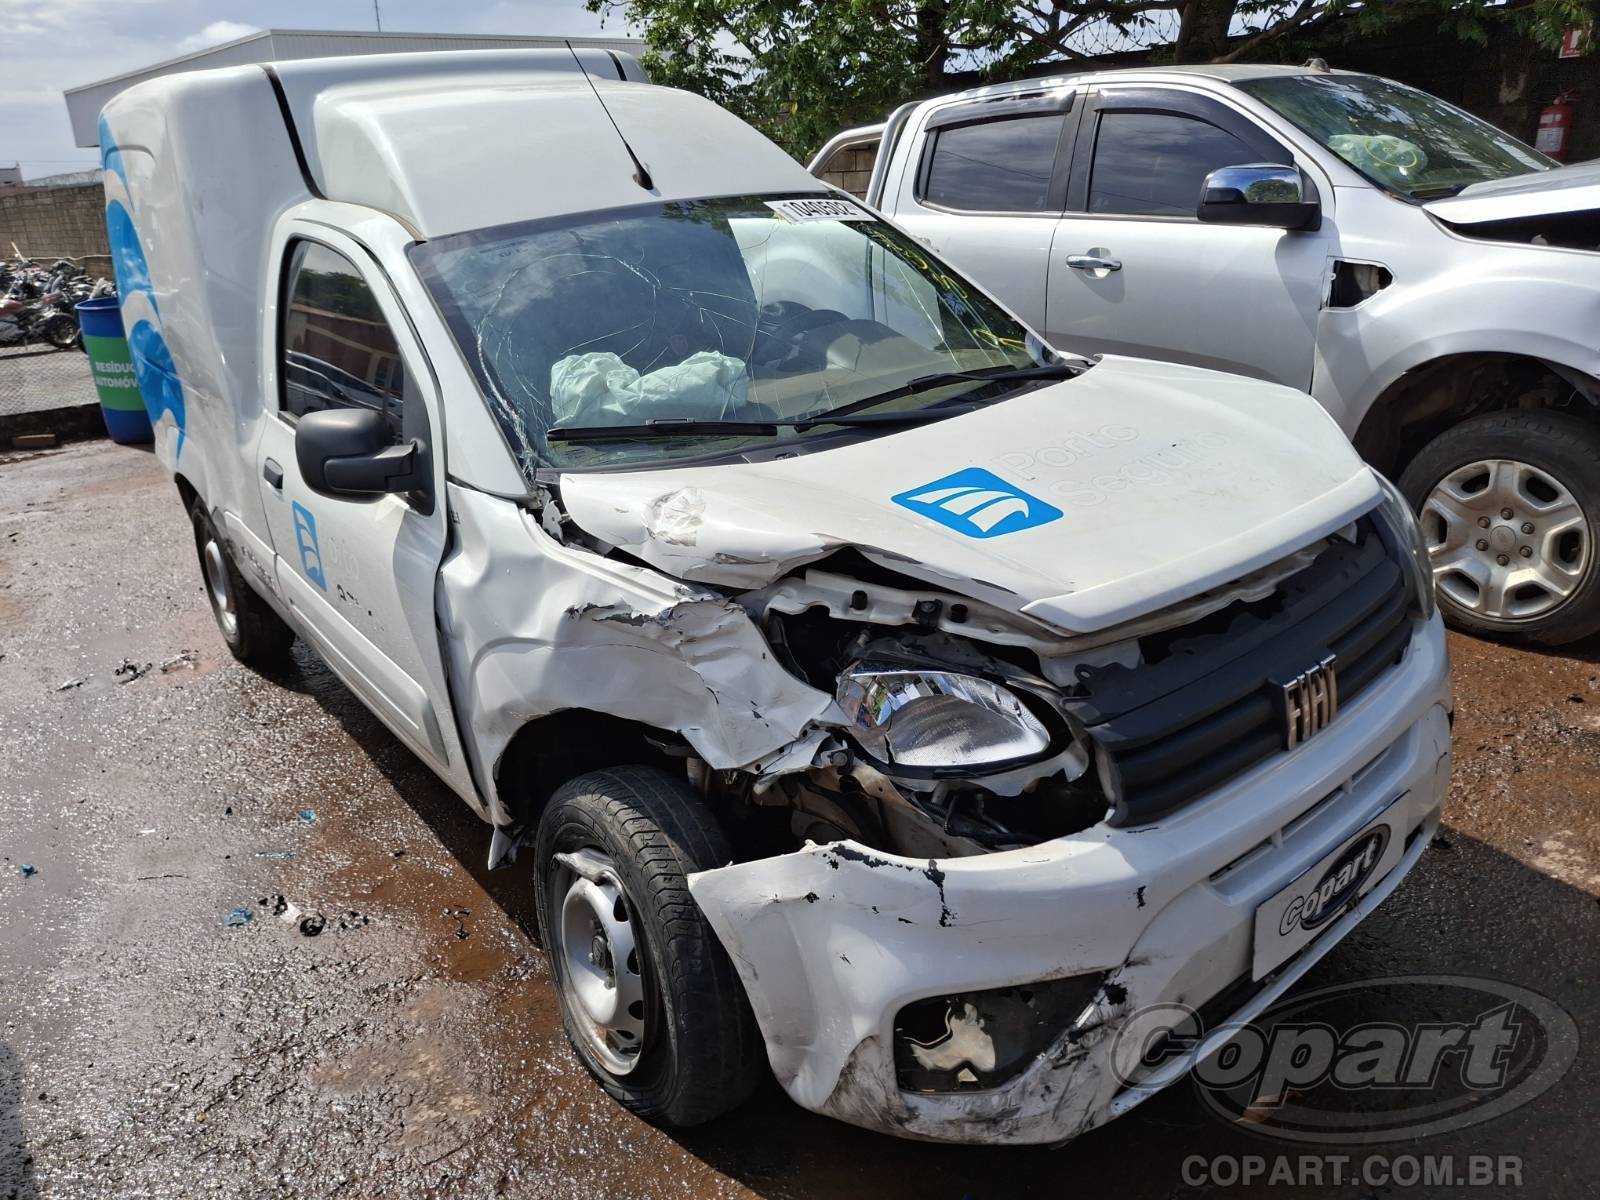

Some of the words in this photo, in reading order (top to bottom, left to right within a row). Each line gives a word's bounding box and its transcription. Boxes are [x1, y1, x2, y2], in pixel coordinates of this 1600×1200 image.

[989, 424, 1140, 481] Porto
[1283, 654, 1338, 750] FIAT
[1278, 837, 1379, 937] Copart
